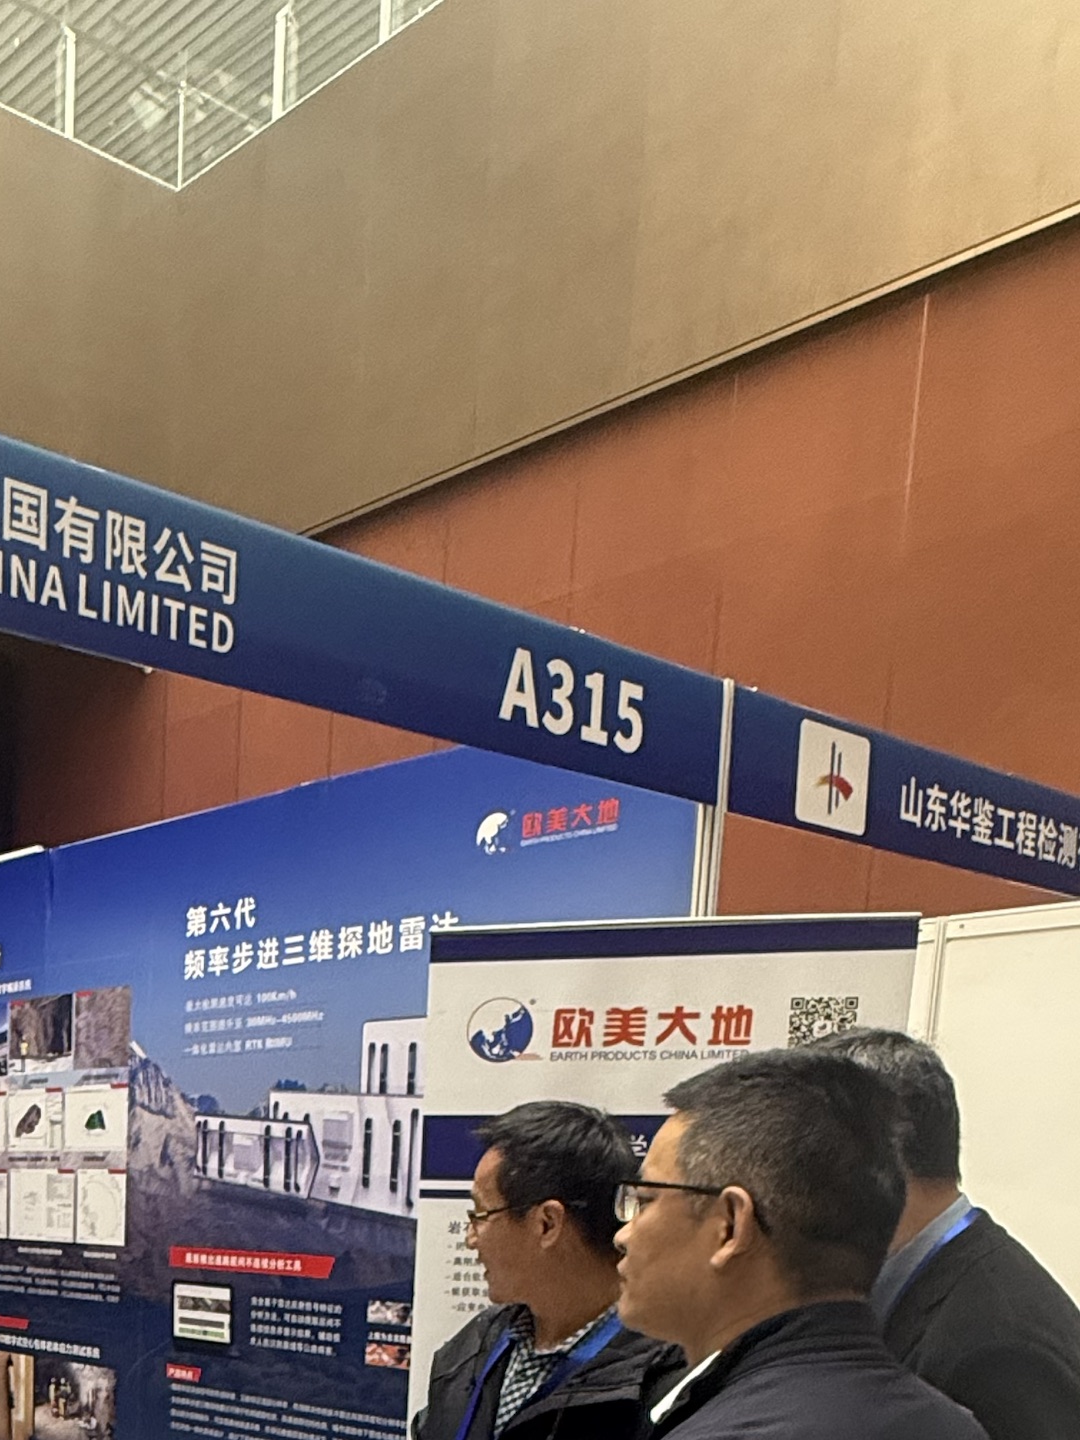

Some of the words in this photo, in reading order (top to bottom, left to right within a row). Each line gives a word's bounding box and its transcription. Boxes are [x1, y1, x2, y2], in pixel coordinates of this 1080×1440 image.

[78, 573, 235, 653] LIMITED
[497, 646, 645, 754] A315
[899, 776, 1080, 869] 山东华鉴工程检测
[185, 897, 257, 938] 第六代
[551, 1004, 754, 1048] 欧美大地
[550, 1051, 587, 1062] EARTH
[591, 1050, 657, 1062] PRODUCTS
[660, 1050, 698, 1061] CHINA
[630, 1134, 647, 1157] 学
